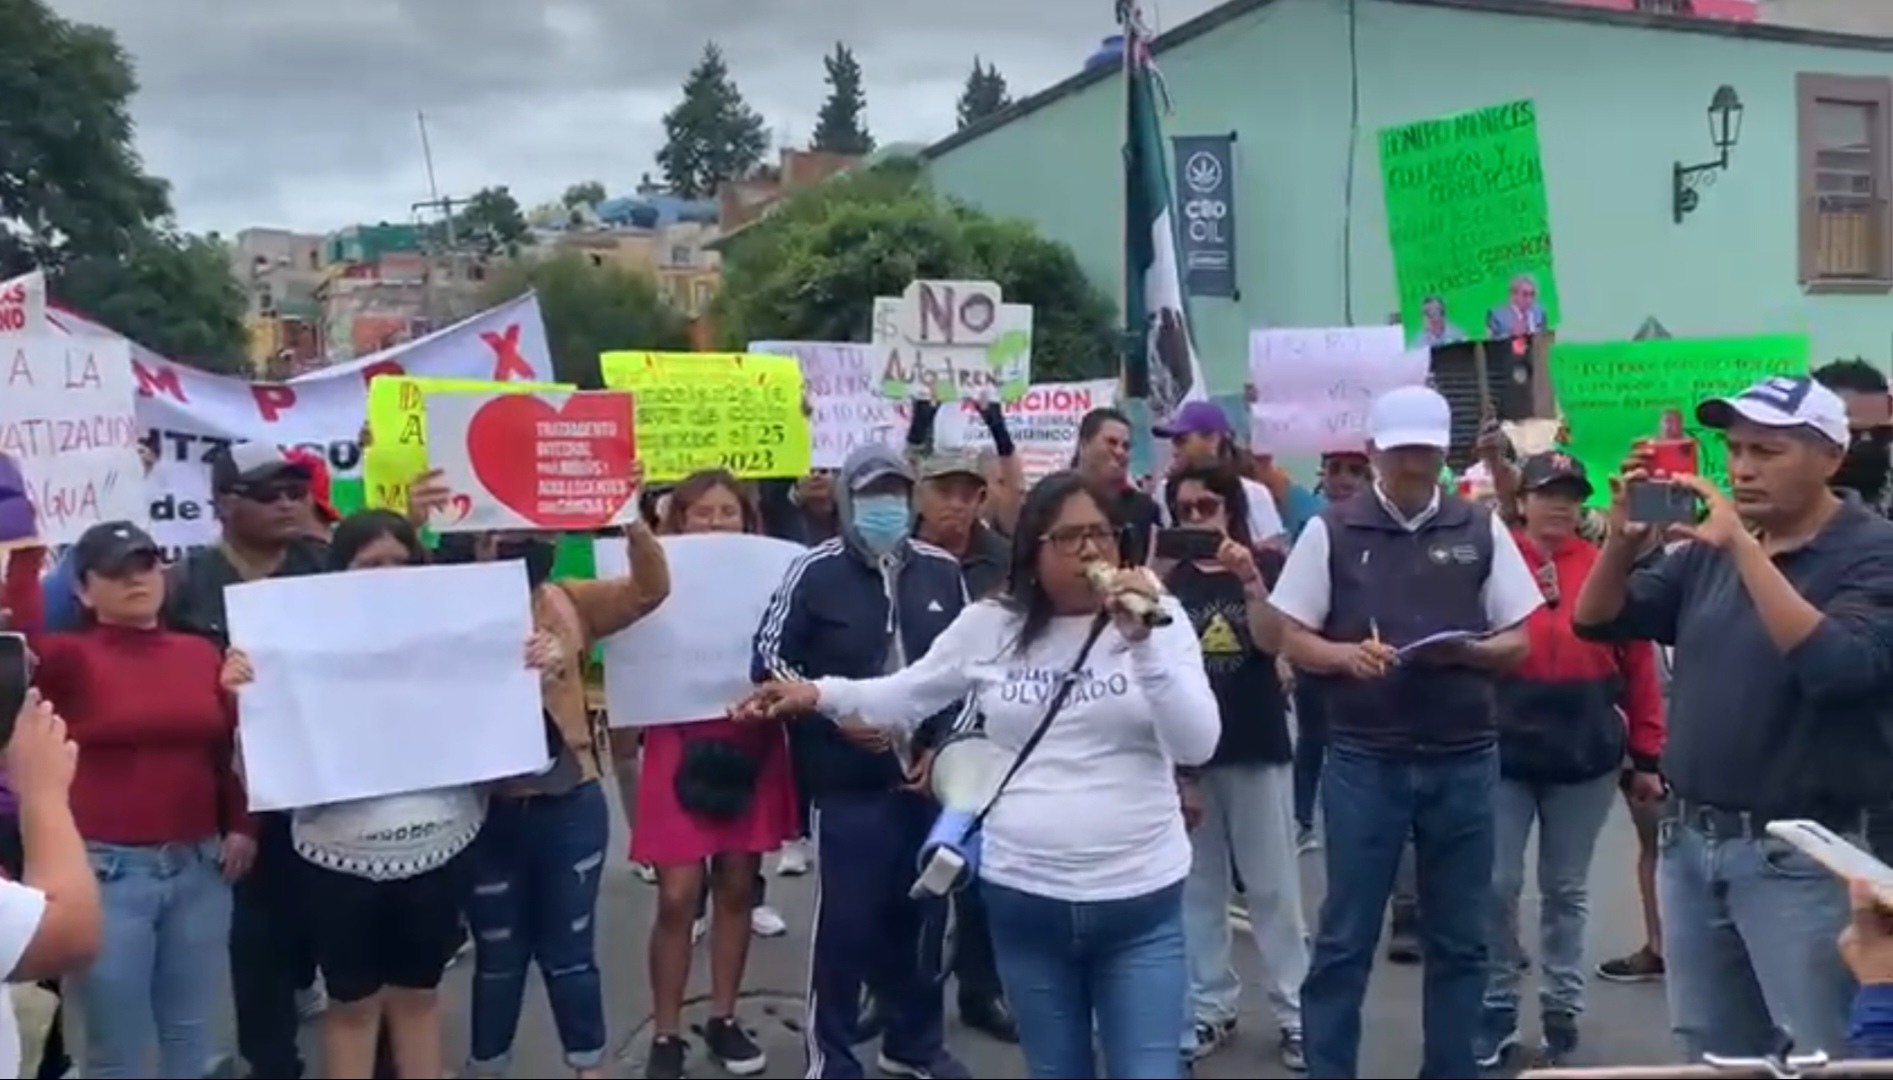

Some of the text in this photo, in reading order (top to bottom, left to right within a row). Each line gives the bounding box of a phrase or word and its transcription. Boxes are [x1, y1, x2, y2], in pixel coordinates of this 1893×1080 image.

[1189, 220, 1225, 242] OIL
[919, 282, 996, 344] NO
[66, 350, 100, 389] LA
[757, 425, 786, 446] 25
[718, 449, 775, 472] 2023
[150, 494, 201, 521] de
